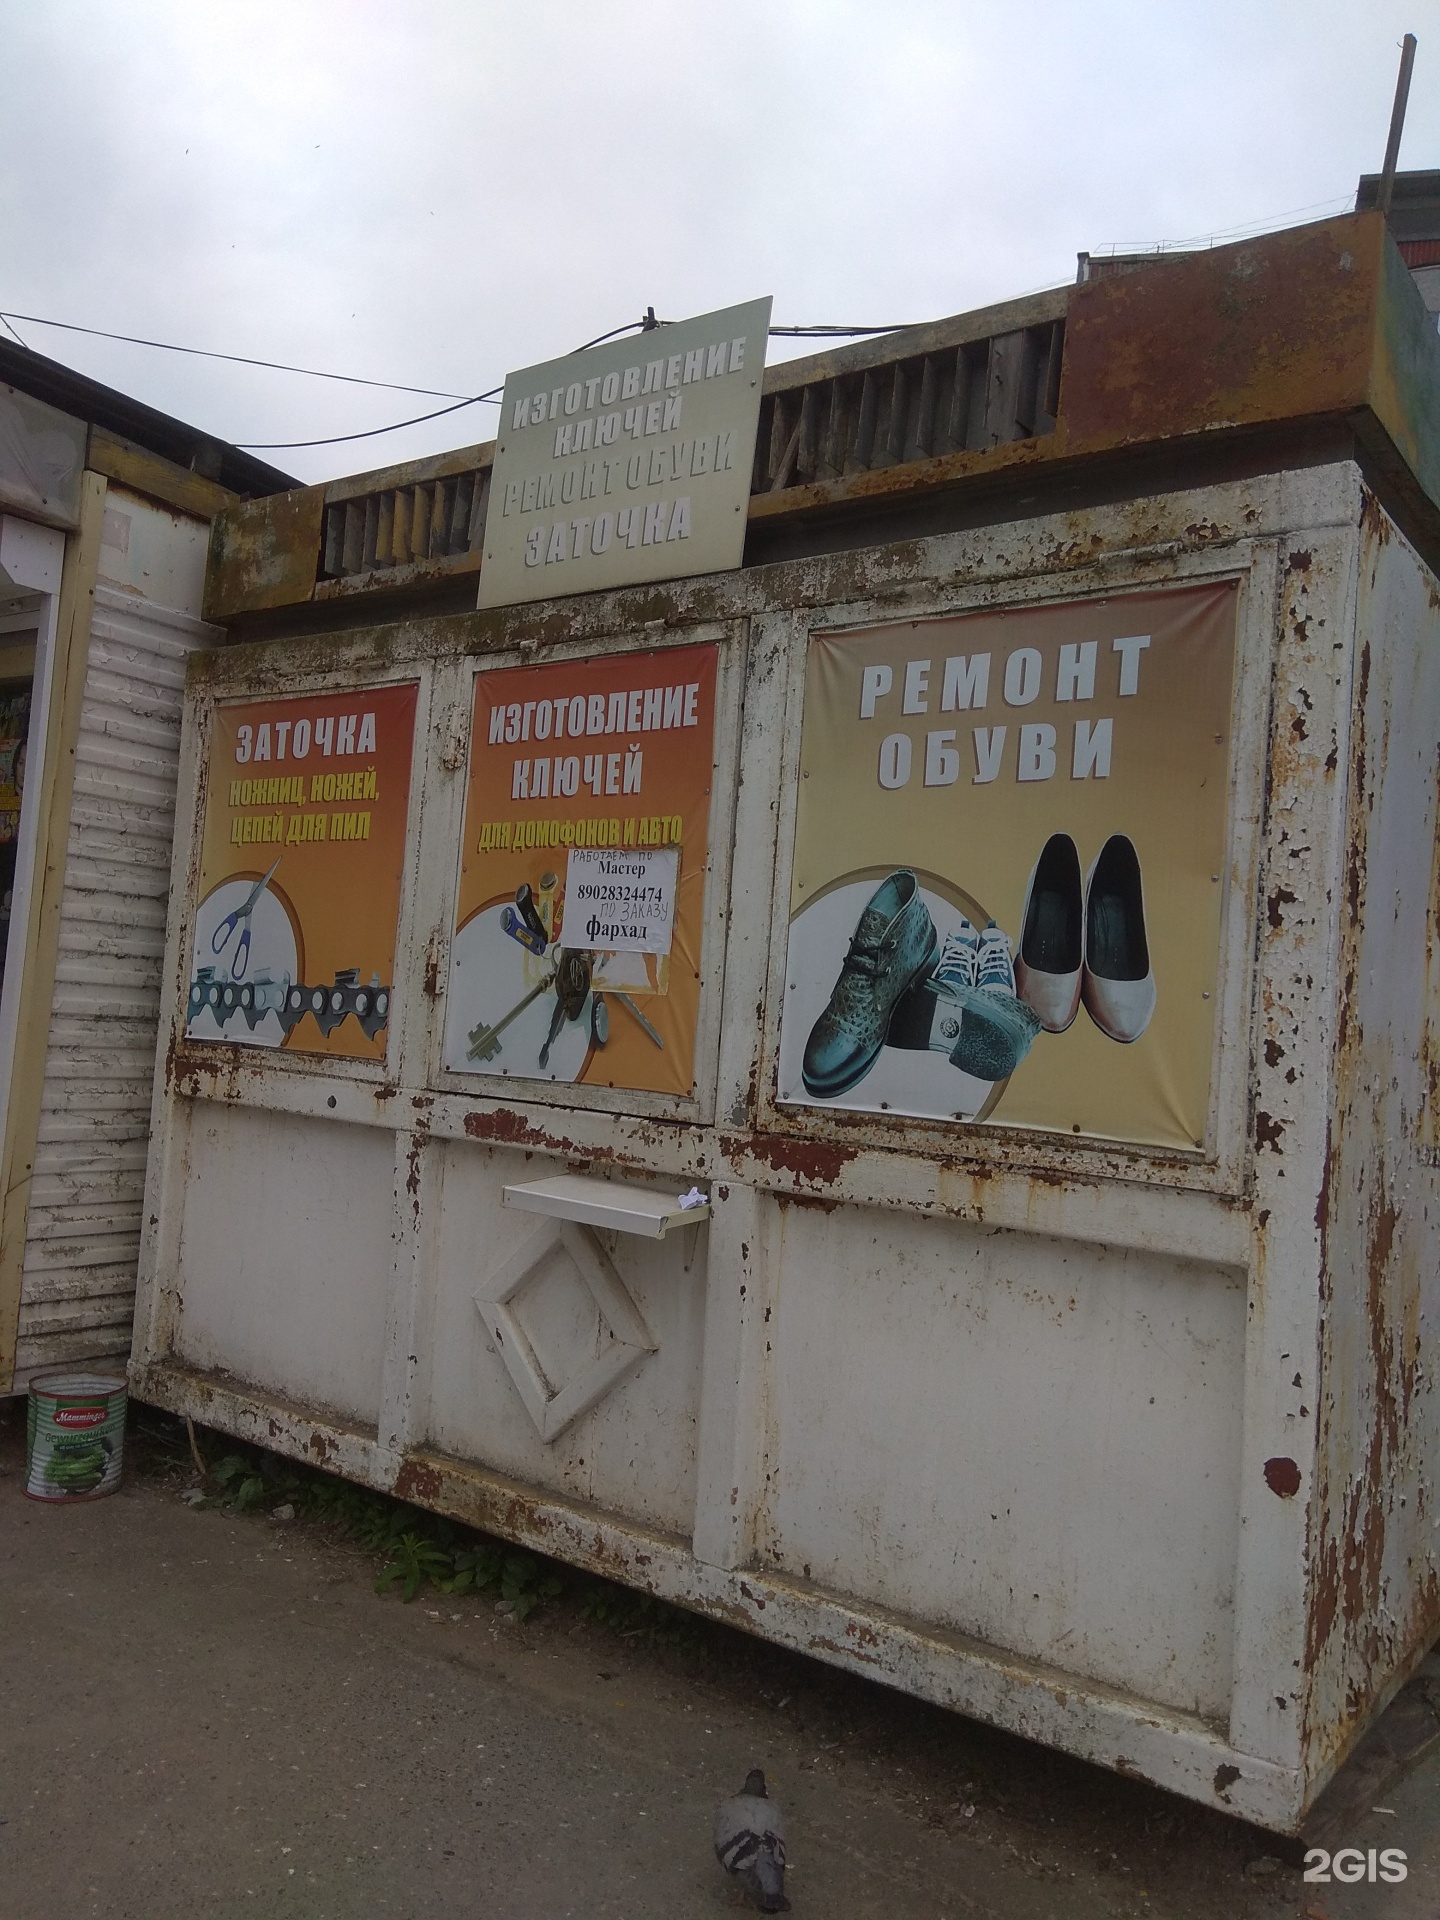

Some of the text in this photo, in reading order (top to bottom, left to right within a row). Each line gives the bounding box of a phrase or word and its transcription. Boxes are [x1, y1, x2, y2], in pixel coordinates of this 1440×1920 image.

[511, 336, 747, 431] ИЗГОТОВЛЕНИЕ
[552, 390, 684, 460] КЛЮЧЕЙ
[502, 429, 739, 518] РЕМОНТ ОБУВИ
[524, 496, 692, 568] ЗАТОЧКА
[858, 635, 1151, 720] РЕМОНТ
[235, 713, 377, 764] ЗАТОЧКА
[488, 683, 699, 744] ИЗГОТОВЛЕНИЕ
[511, 742, 643, 801] КЛЮЧЕЙ
[877, 717, 1114, 791] ОБУВИ
[228, 765, 380, 808] НОЖНИЦ, НОЖЕЙ,
[230, 810, 371, 848] ЦЕПЕЙ ДЛЯ ПИЛ
[477, 815, 683, 853] ДЛЯ ДОМОФОНОВ И АВТО
[577, 884, 663, 902] 89028324474
[598, 861, 646, 879] Мастер
[600, 902, 669, 921] ПО ЗАКАЗУ
